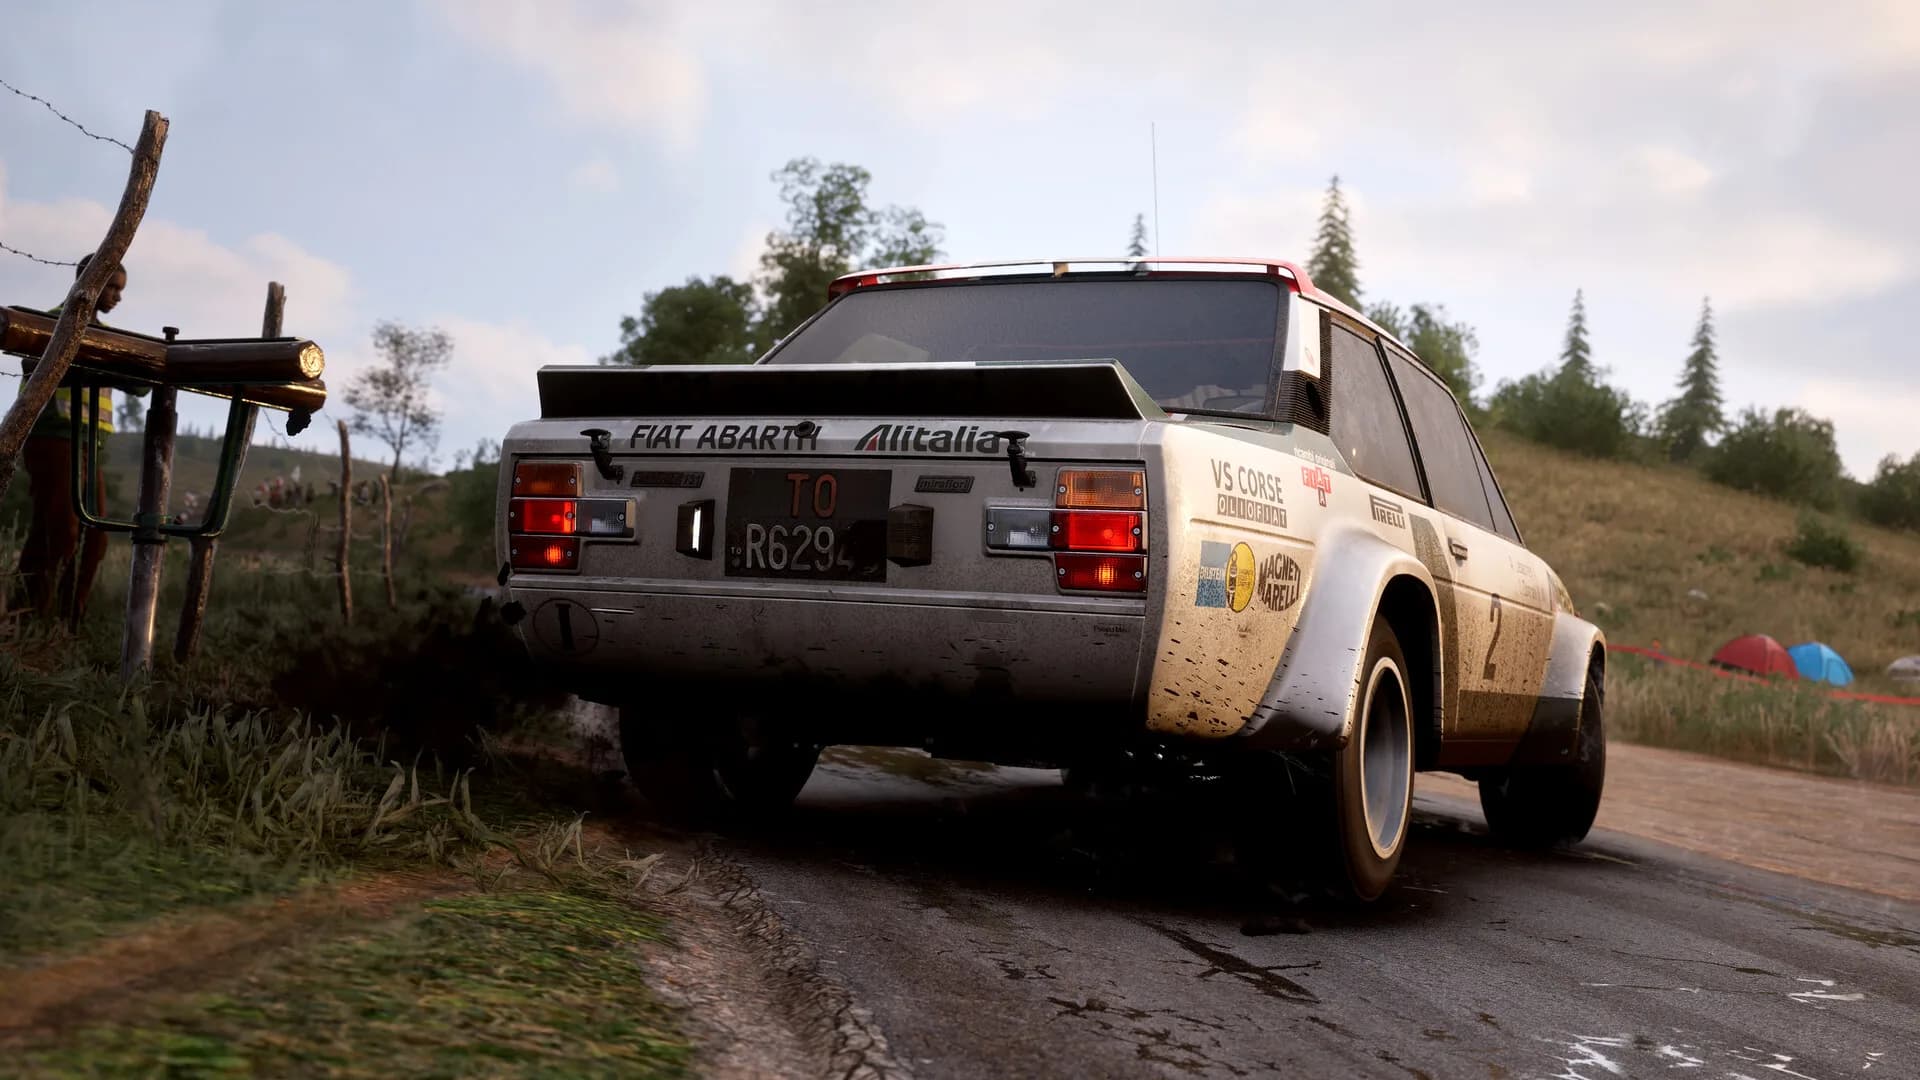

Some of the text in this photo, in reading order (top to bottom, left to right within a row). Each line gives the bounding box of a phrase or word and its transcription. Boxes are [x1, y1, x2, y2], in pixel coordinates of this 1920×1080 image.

[631, 424, 818, 451] FIAT ABARTH
[854, 424, 1001, 453] Alitalia
[785, 472, 838, 519] TO
[1211, 458, 1283, 504] VS CORSE
[1301, 466, 1331, 494] FIAT
[745, 523, 881, 573] R6294
[1258, 553, 1301, 585] MAGNETI
[1257, 581, 1301, 612] MARELLI
[1483, 593, 1502, 680] 2
